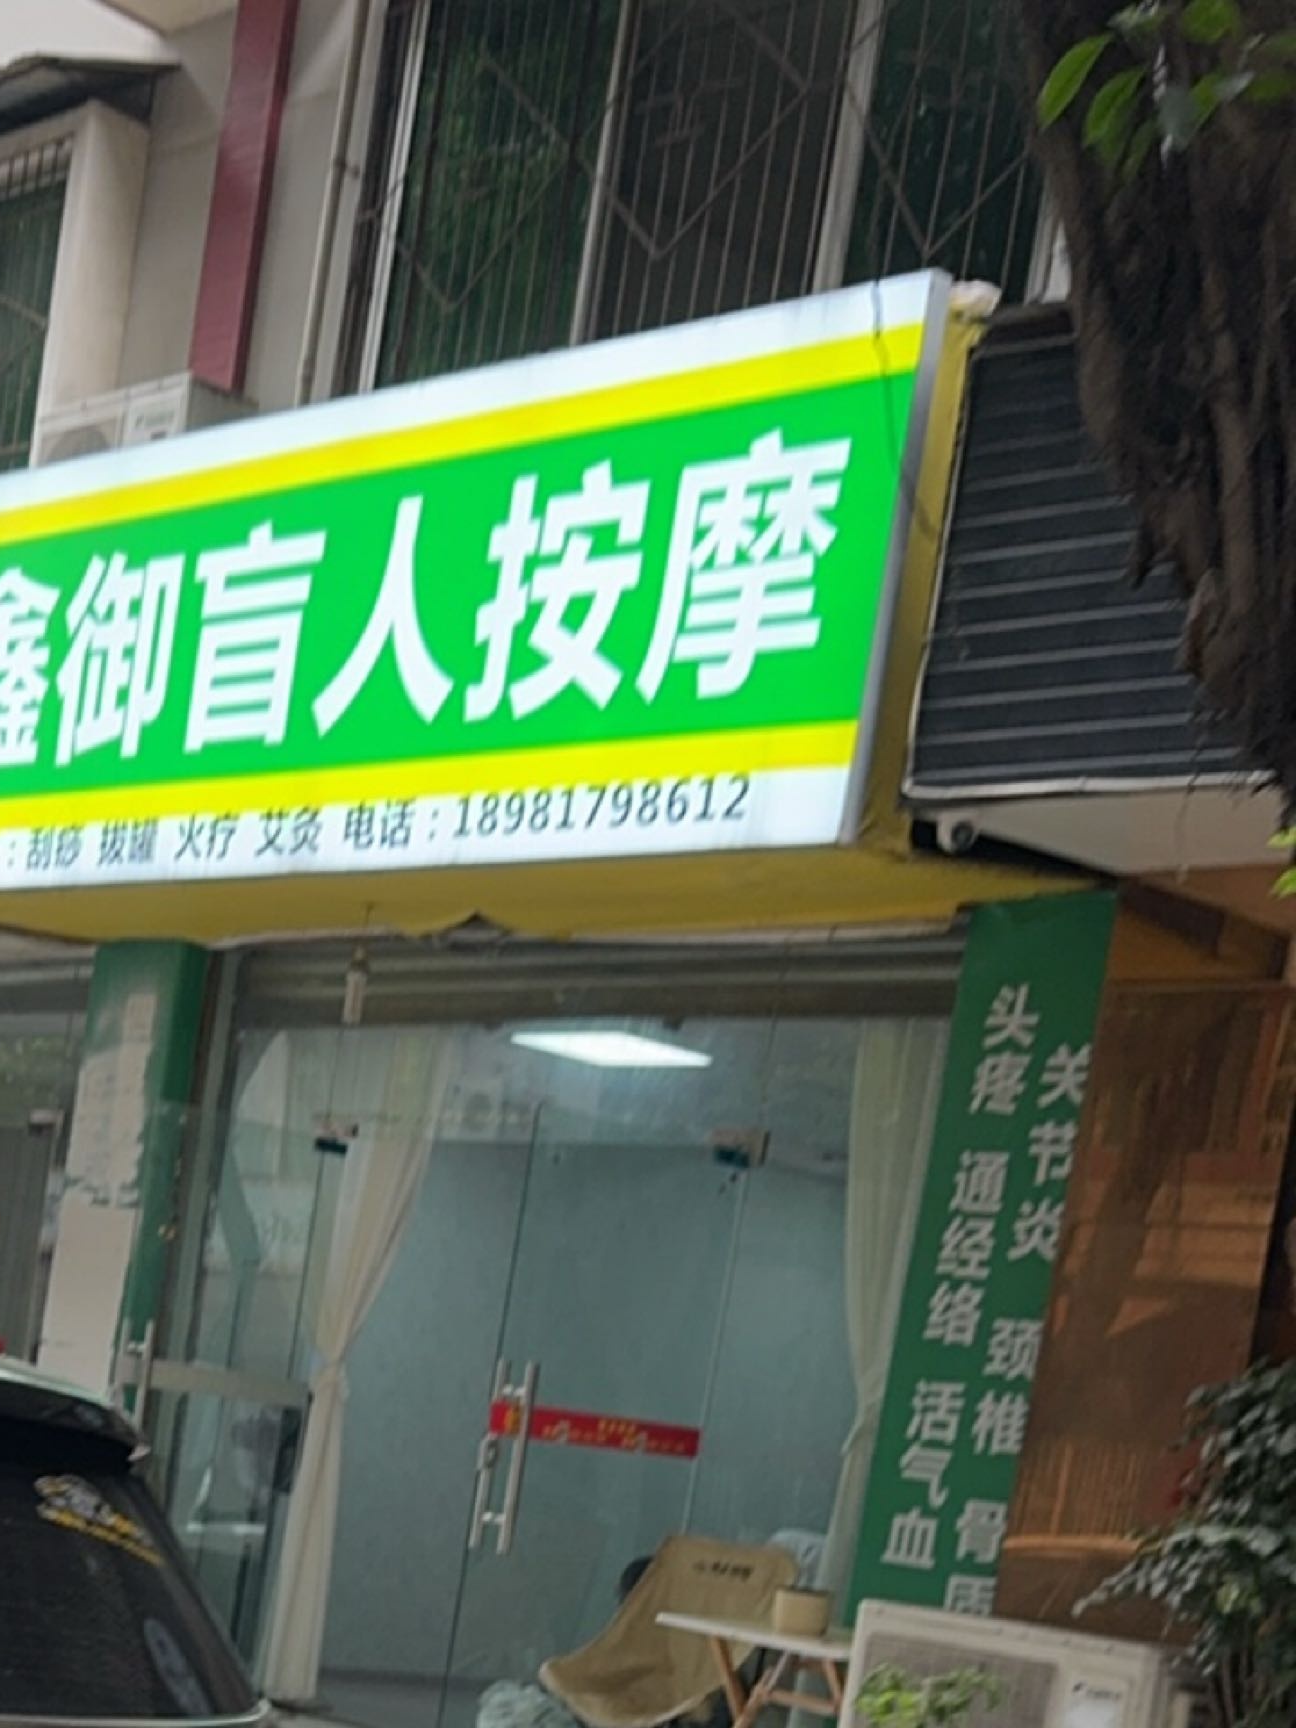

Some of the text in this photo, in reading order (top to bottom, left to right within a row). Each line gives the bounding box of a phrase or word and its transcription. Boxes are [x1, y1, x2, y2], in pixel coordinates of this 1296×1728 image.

[97, 816, 159, 868] 拔罐
[174, 812, 240, 862] 火疗
[255, 804, 324, 858] 艾灸
[1007, 1041, 1092, 1262] 关节炎
[881, 982, 1040, 1570] 头疼 通经络 活气血
[972, 1317, 1045, 1456] 颈椎
